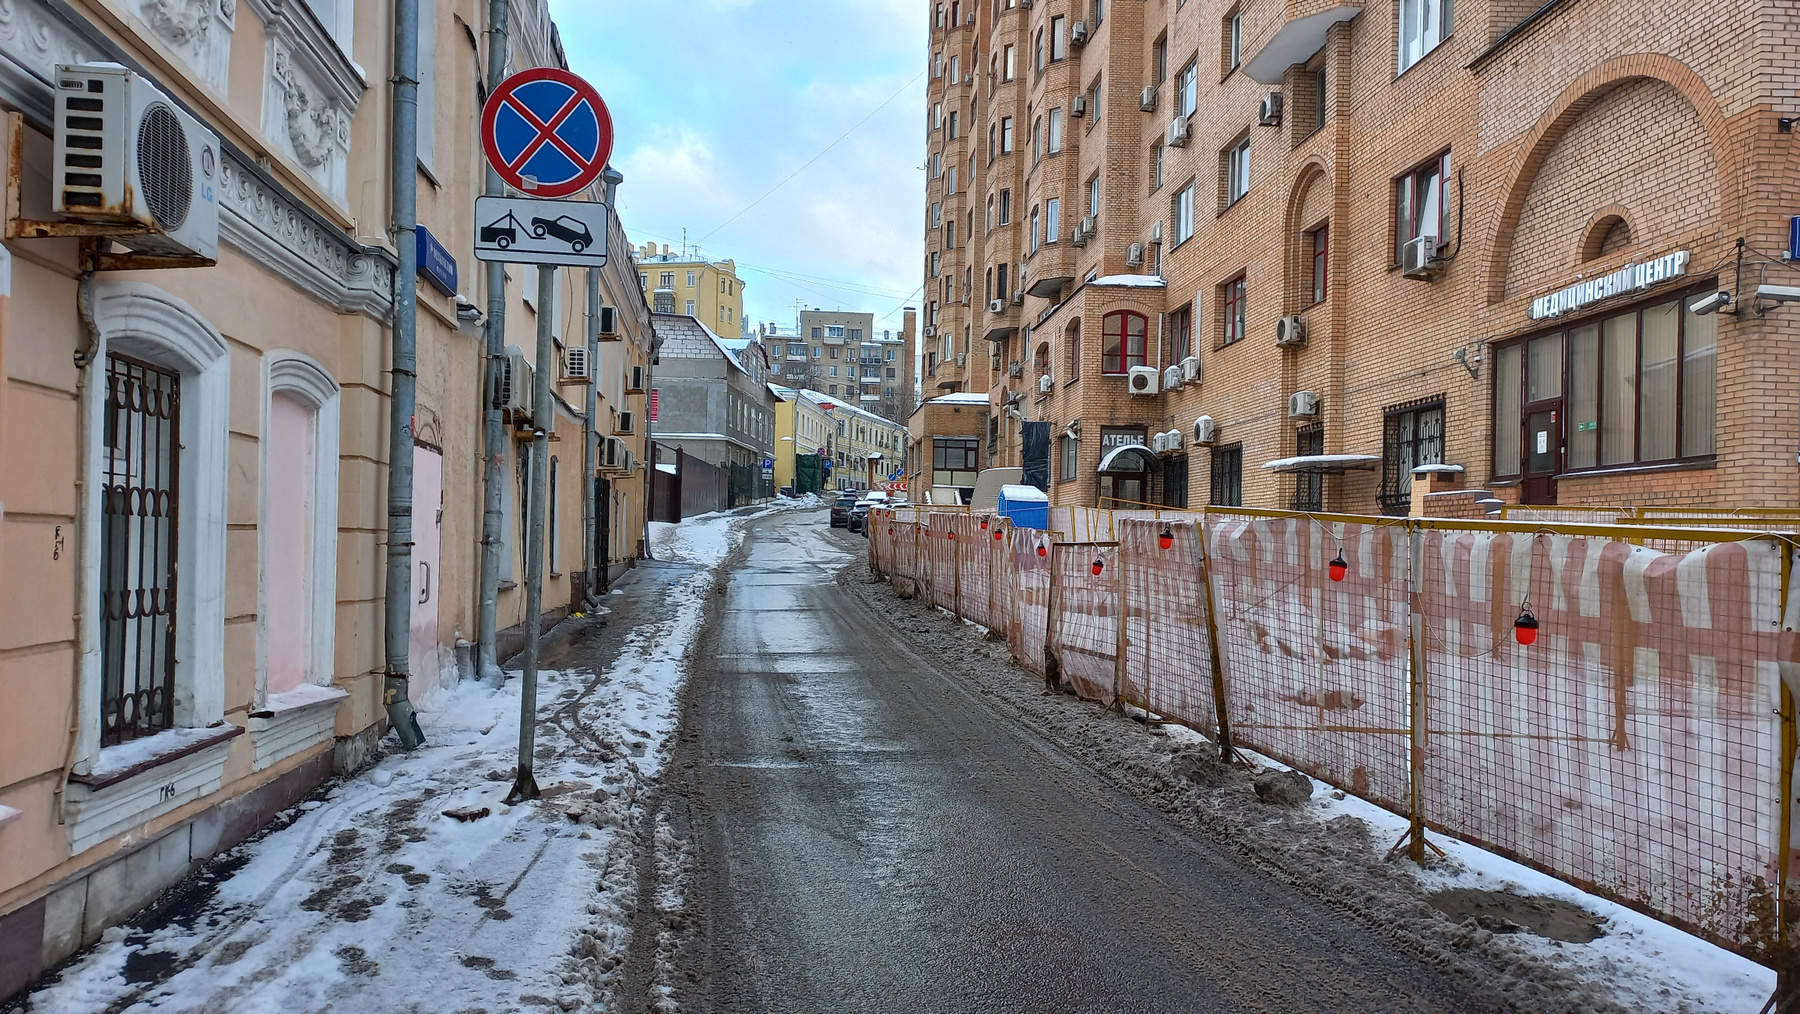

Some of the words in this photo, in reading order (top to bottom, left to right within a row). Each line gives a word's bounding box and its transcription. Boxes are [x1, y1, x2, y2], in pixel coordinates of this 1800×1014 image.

[202, 182, 213, 203] LG
[1532, 263, 1634, 320] МЕДИЦИНСКИЙ
[1635, 251, 1687, 289] ЦЕНТР
[1102, 434, 1144, 446] АТЕЛЬЕ
